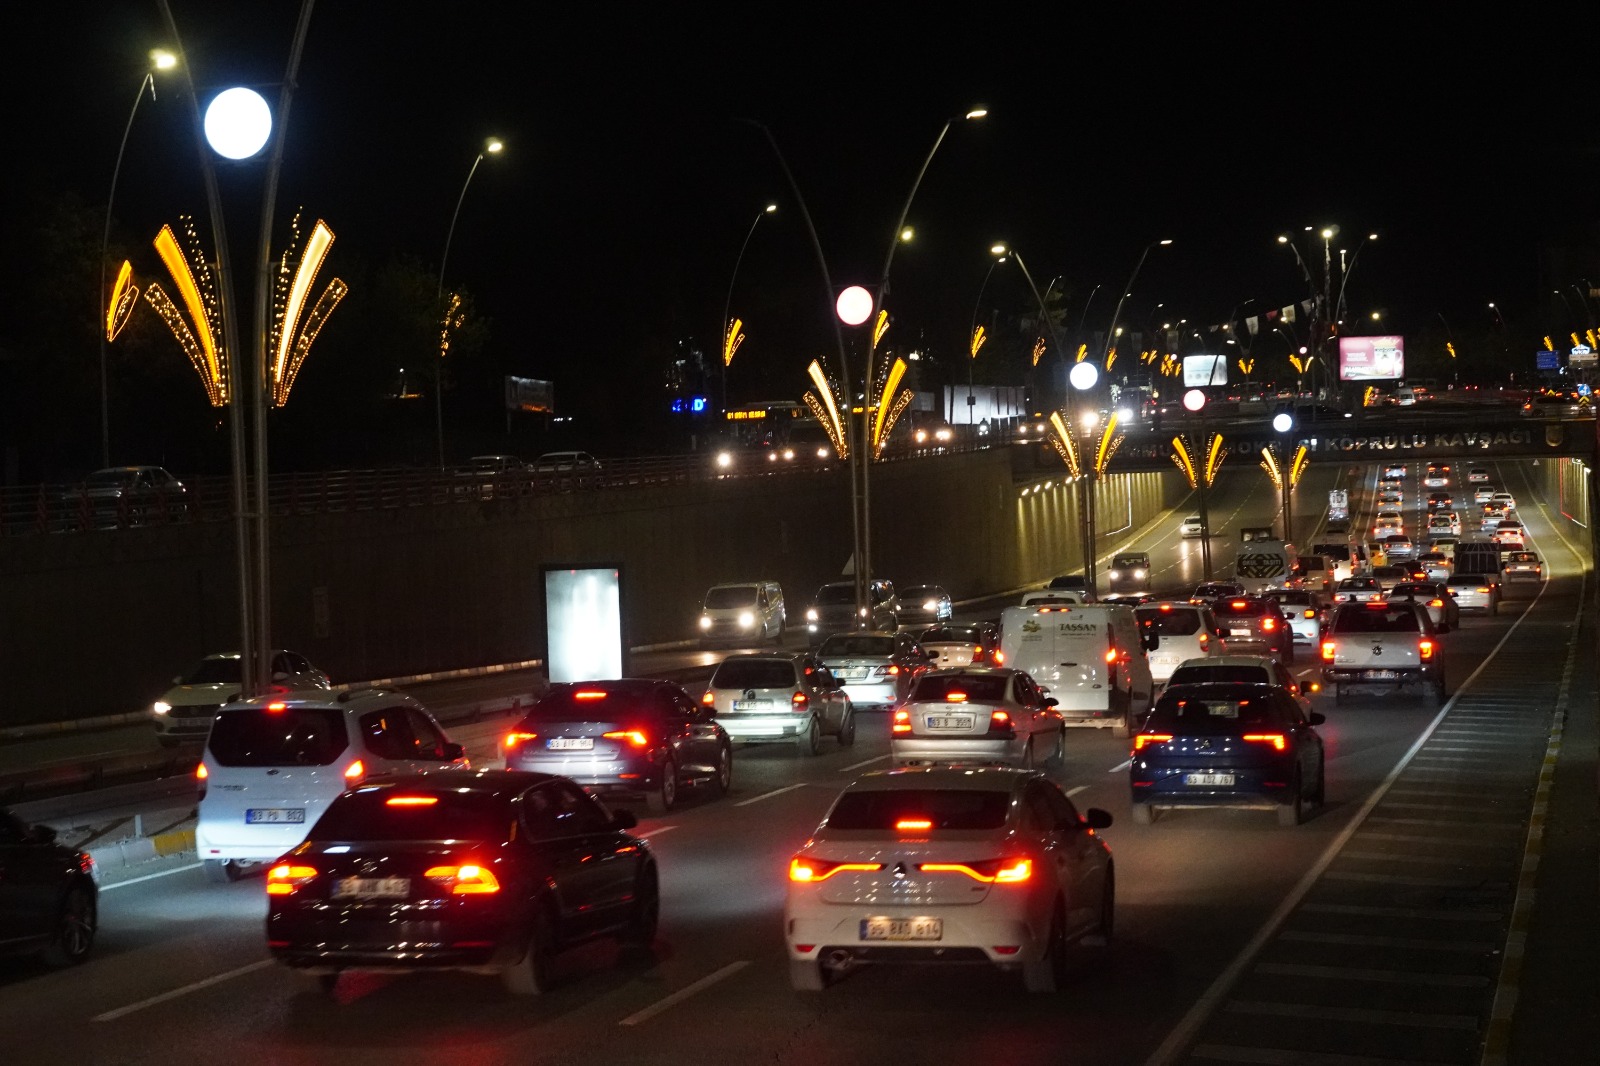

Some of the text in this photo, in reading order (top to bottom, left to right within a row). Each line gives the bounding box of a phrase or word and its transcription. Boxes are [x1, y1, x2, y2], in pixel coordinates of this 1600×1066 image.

[1324, 433, 1427, 451] KÖPRÜLÜ
[1434, 428, 1532, 449] KAVŞAĞI
[1059, 623, 1097, 631] TASSAN
